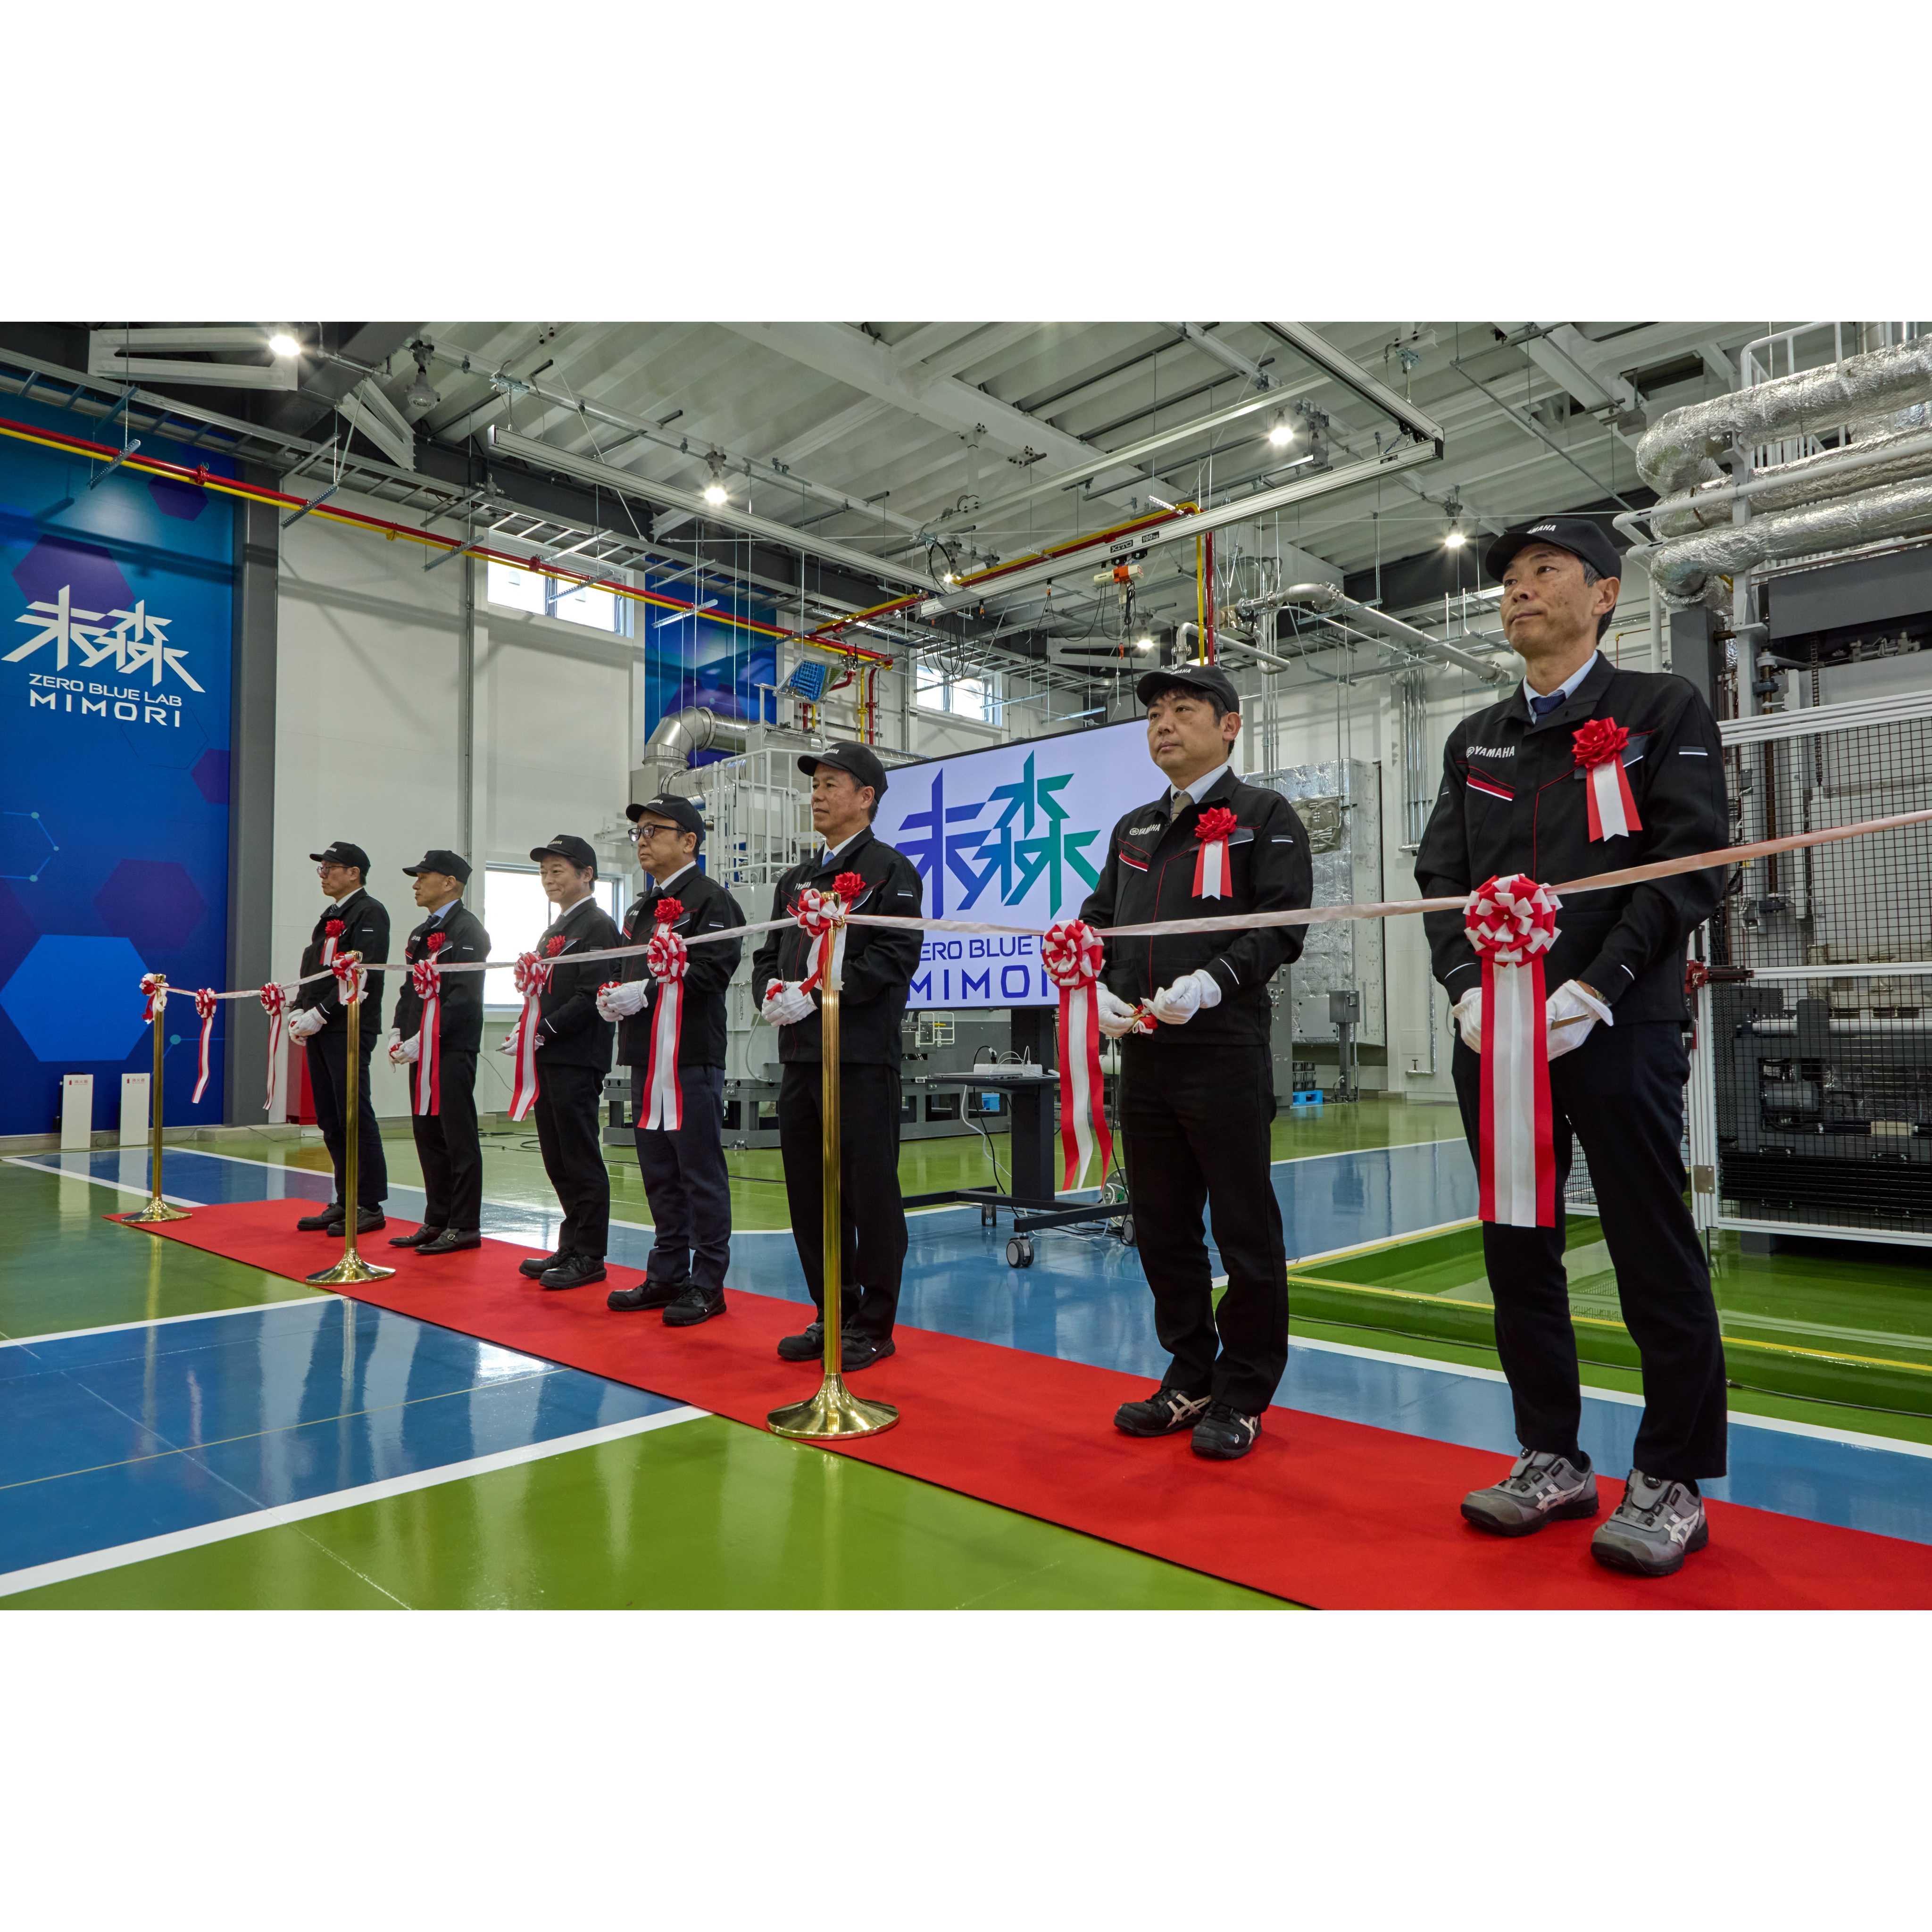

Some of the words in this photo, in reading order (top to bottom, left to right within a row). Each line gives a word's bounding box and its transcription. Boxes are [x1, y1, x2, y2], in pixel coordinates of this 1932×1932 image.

[1526, 525, 1556, 534] AMAHA
[1111, 541, 1132, 552] KITO
[29, 673, 84, 692] ZERO
[89, 683, 140, 701] BLUE
[144, 691, 182, 707] LAB
[30, 689, 180, 727] MIMORI
[1474, 746, 1515, 758] YAMAHA
[920, 941, 963, 961] ERO
[969, 935, 1033, 958] BLUE
[908, 964, 1059, 1001] MIMO
